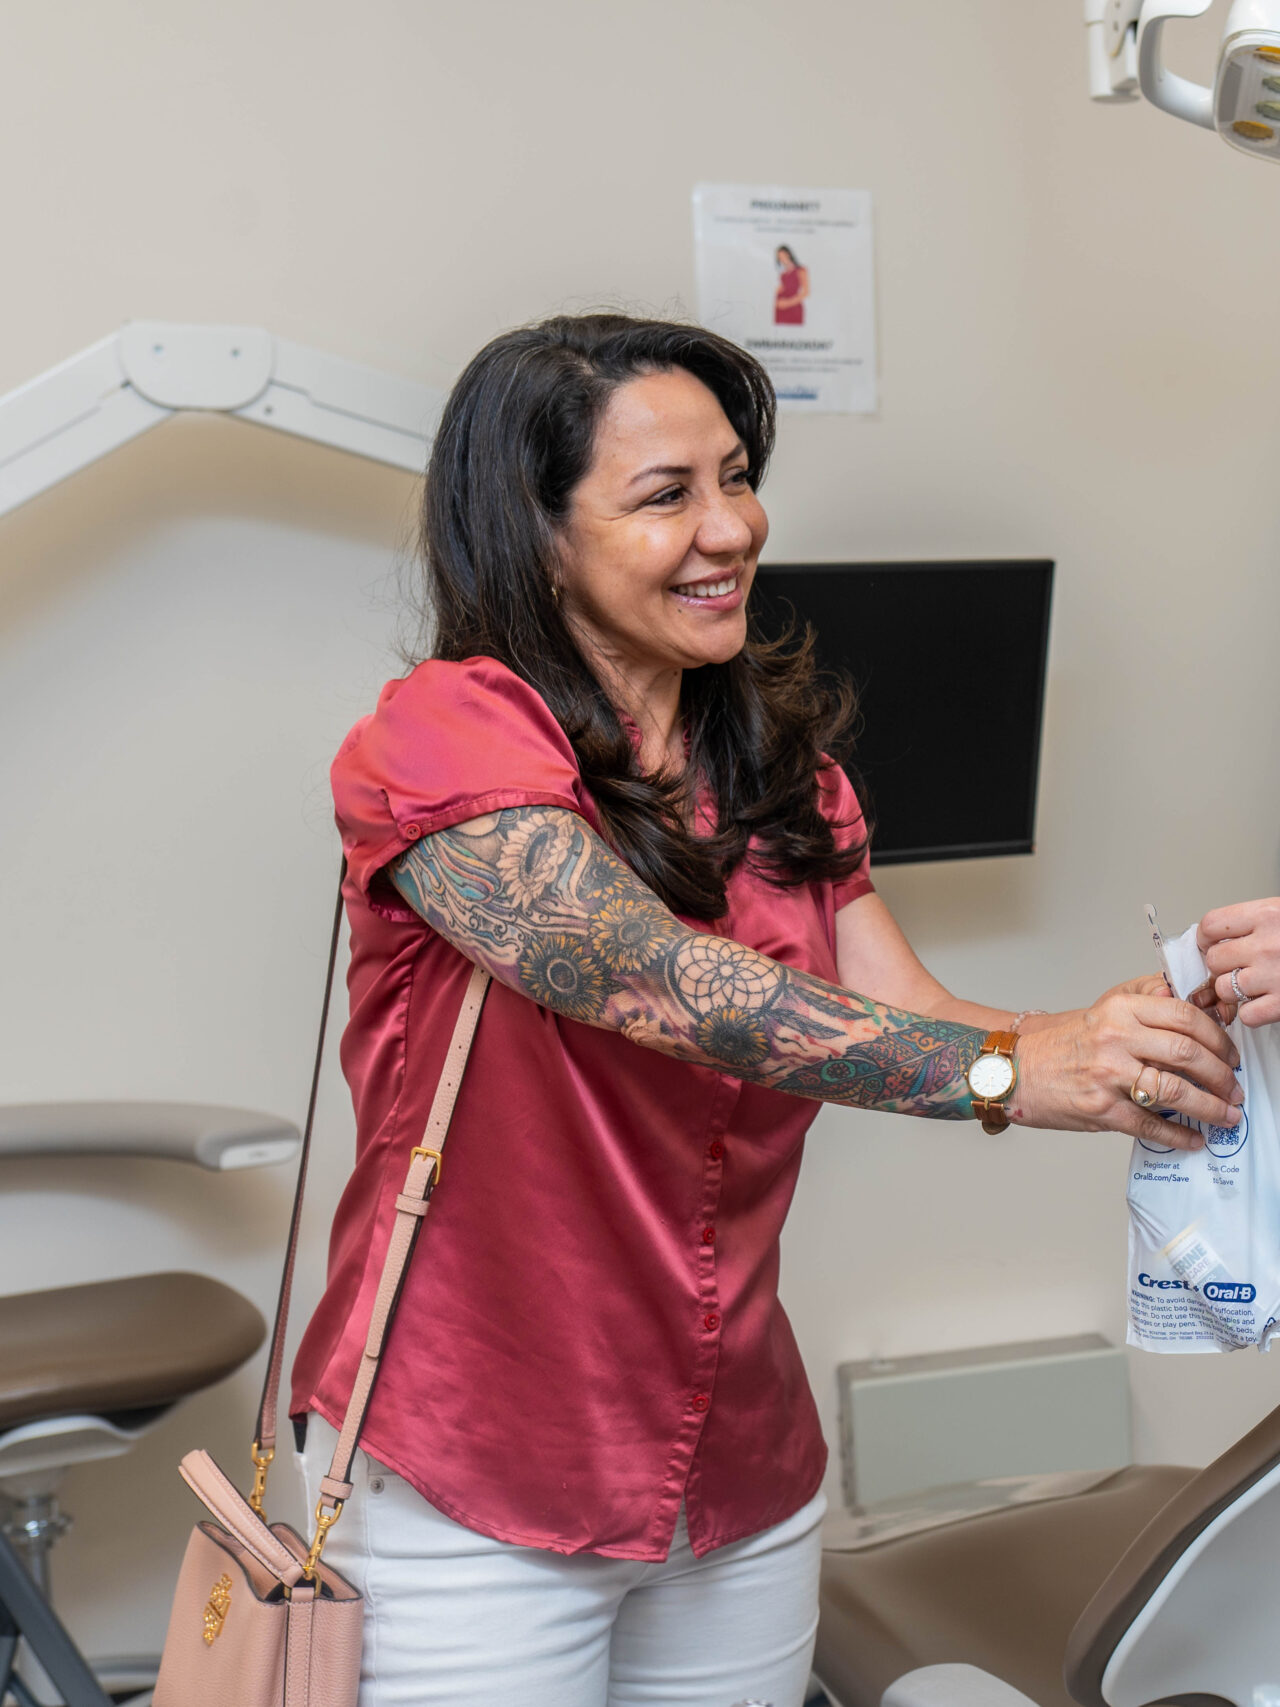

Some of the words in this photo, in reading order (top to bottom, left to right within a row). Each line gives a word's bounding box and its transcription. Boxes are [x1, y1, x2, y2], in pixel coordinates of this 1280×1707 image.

[1144, 1161, 1171, 1171] Register
[1221, 1165, 1240, 1173] Code
[1134, 1172, 1189, 1183] OralB.com/Save
[1138, 1273, 1190, 1290] Crest
[1151, 1304, 1172, 1312] plastic
